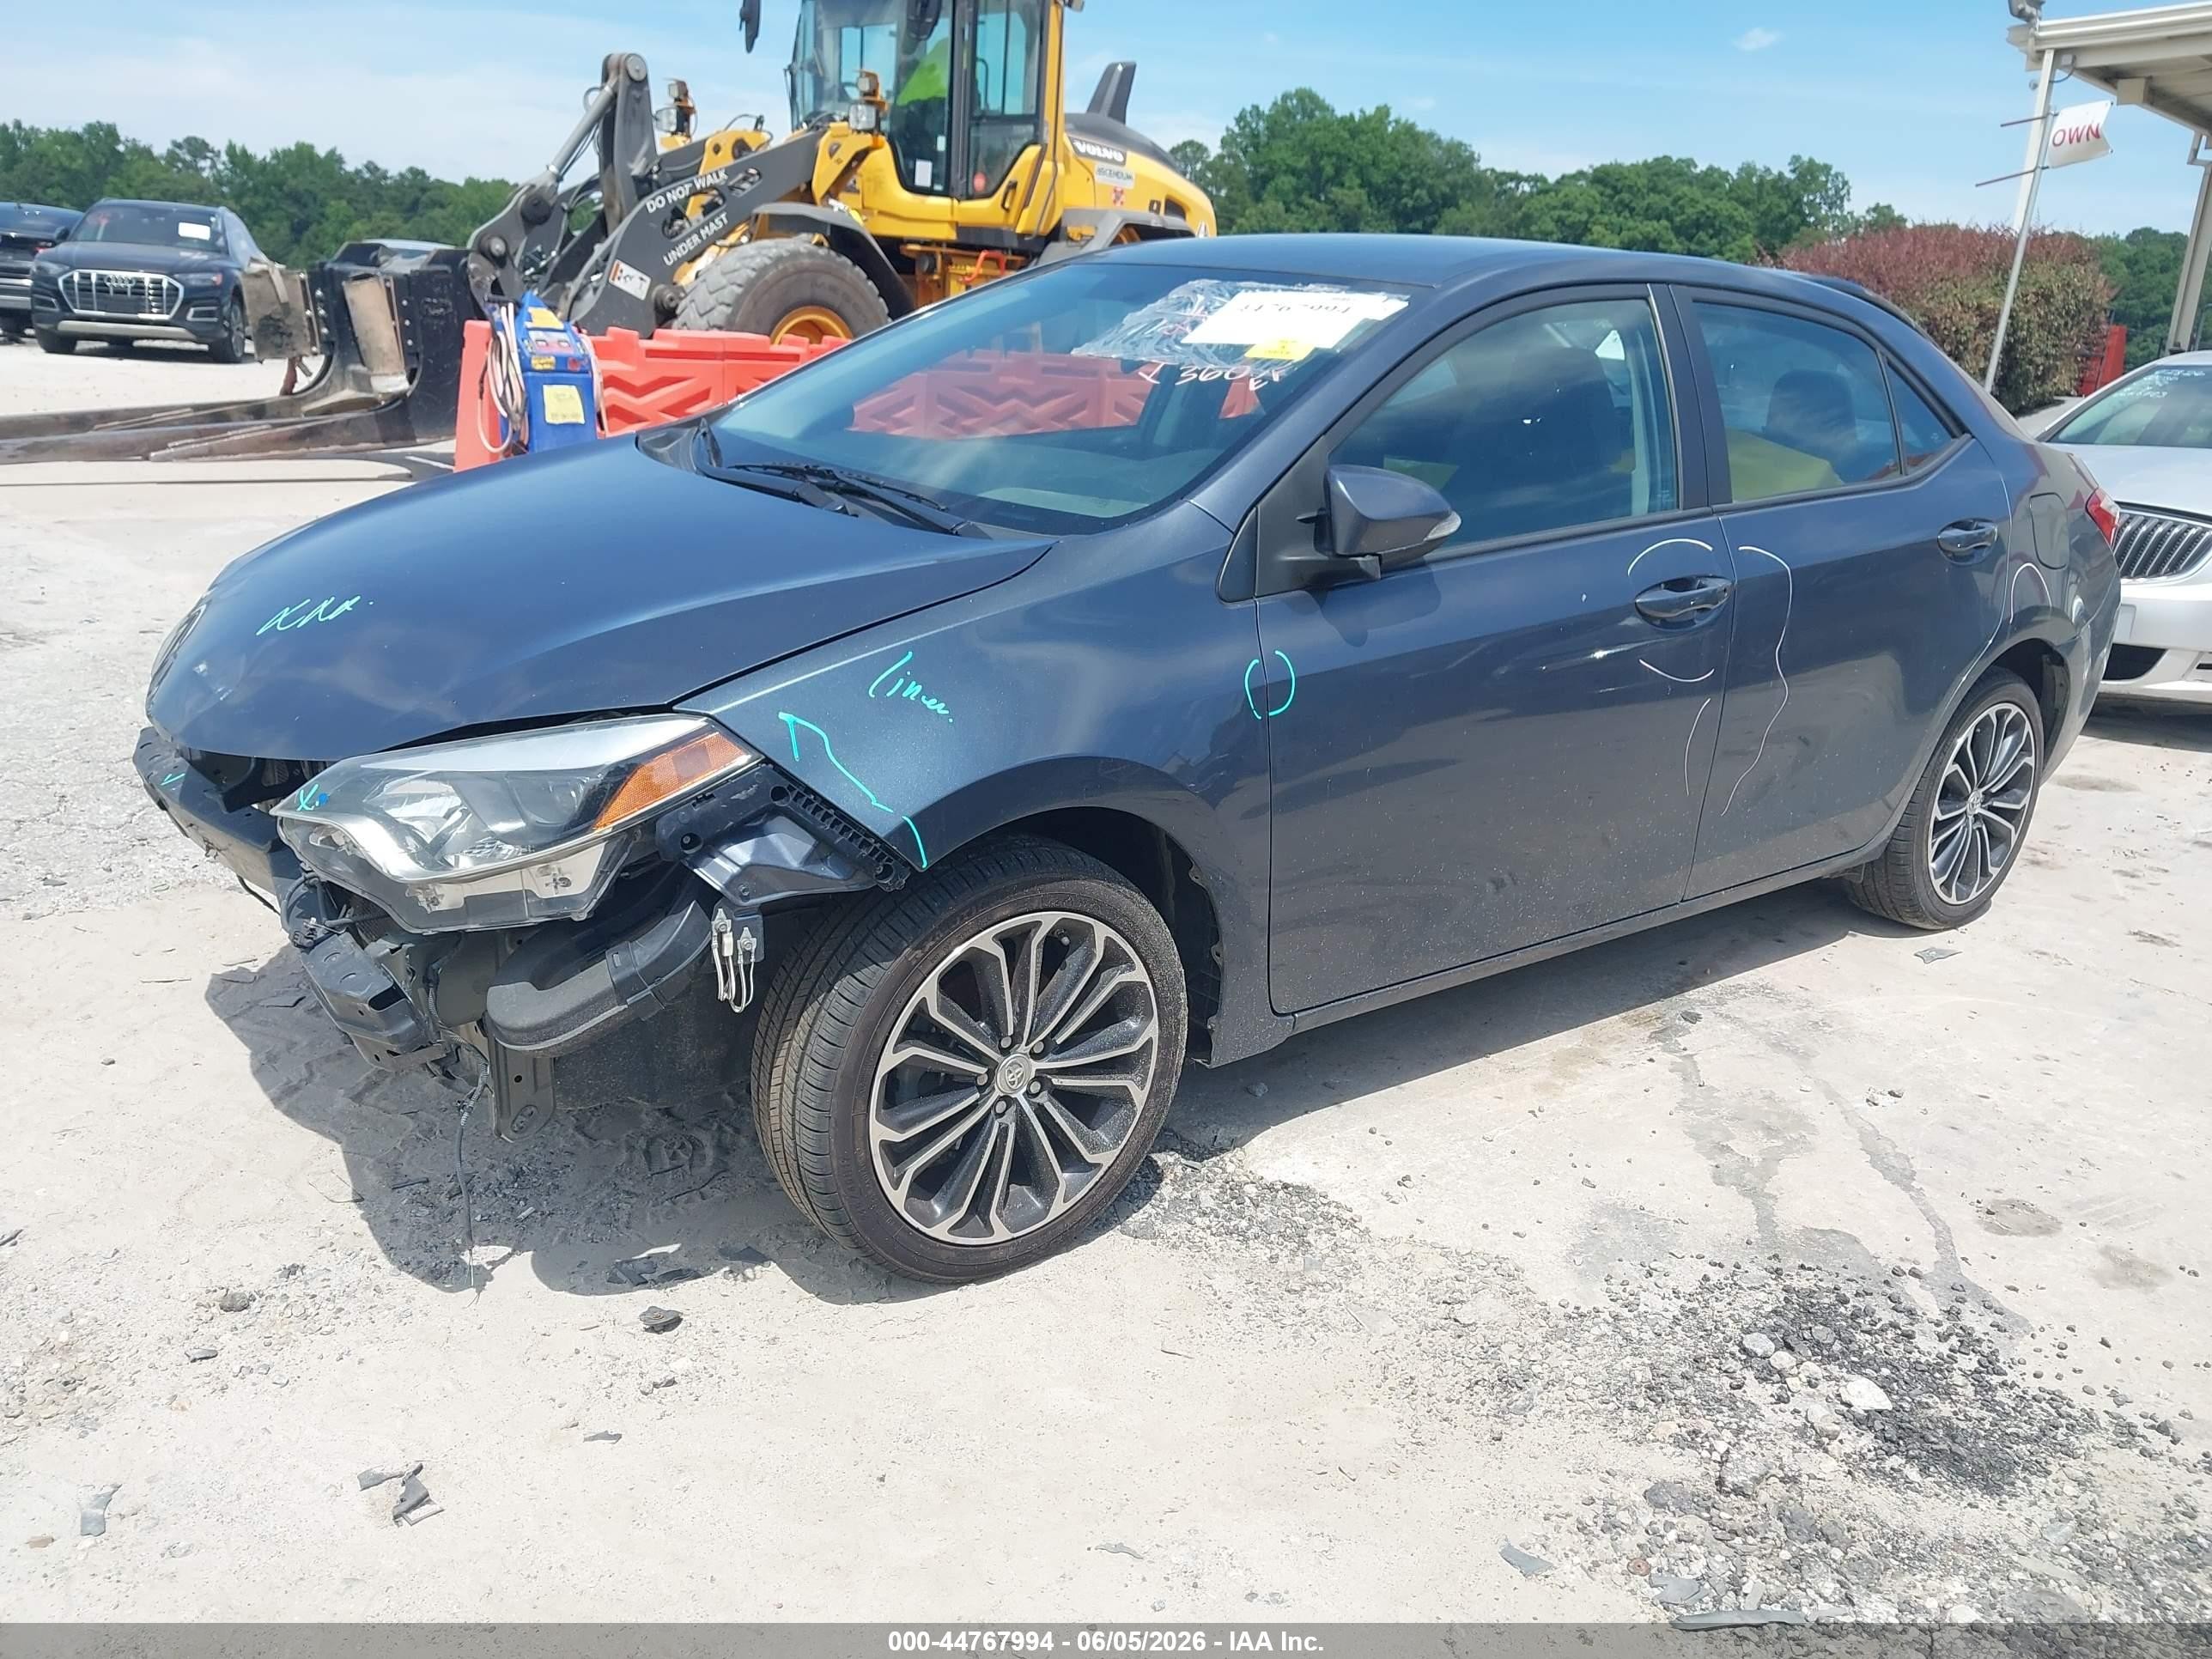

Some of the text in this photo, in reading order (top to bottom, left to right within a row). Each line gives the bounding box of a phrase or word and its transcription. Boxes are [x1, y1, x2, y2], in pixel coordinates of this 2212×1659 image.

[1073, 139, 1125, 162] VOLVO
[2052, 123, 2101, 147] OWN
[646, 168, 729, 214] DO NOT WALK
[662, 212, 729, 265] UNDER MAST
